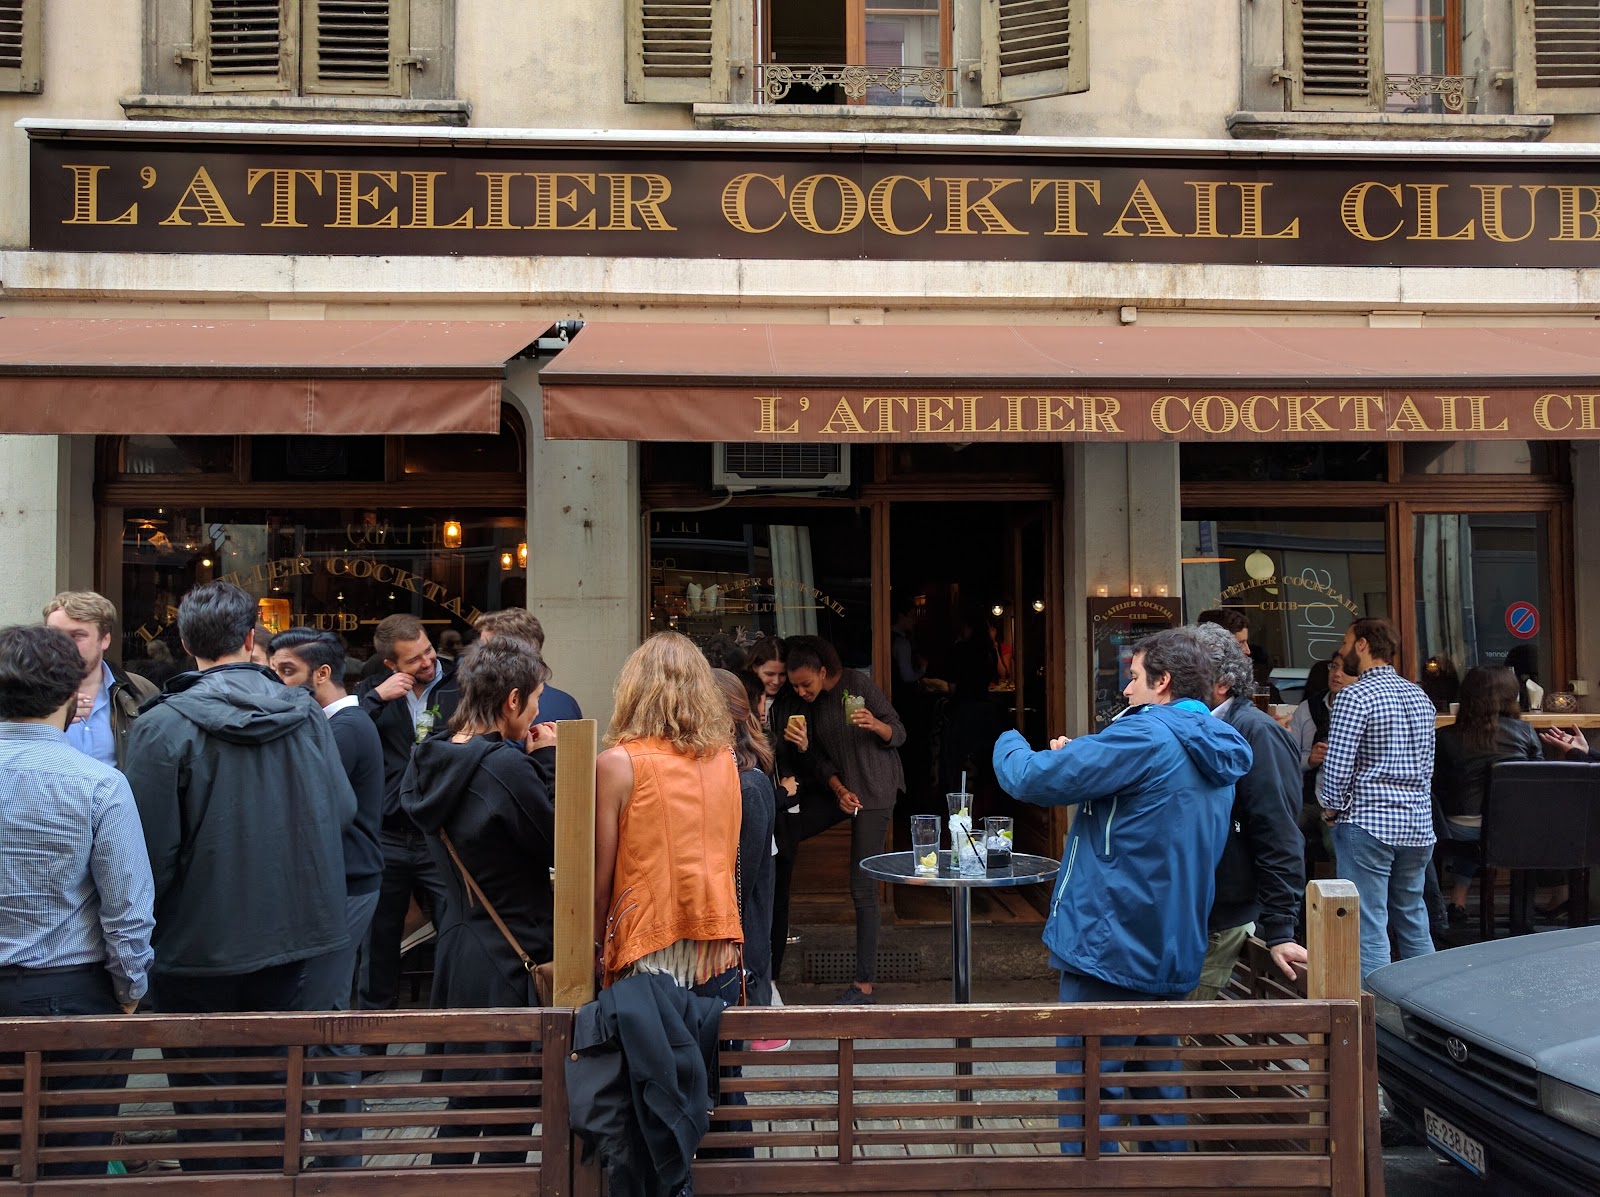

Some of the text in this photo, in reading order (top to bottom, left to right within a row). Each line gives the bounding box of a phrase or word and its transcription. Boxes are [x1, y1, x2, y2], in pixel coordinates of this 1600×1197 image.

[61, 164, 1600, 242] L'ATELIER COCKTAIL CLUB
[753, 395, 1124, 434] L'ATELIER
[1151, 394, 1509, 433] COCKTAIL
[326, 557, 482, 627] COCKTAI
[1101, 600, 1174, 621] L'ATELIER COCKTAIL
[1260, 601, 1298, 611] CLUB
[1282, 575, 1359, 616] COCKTAIL
